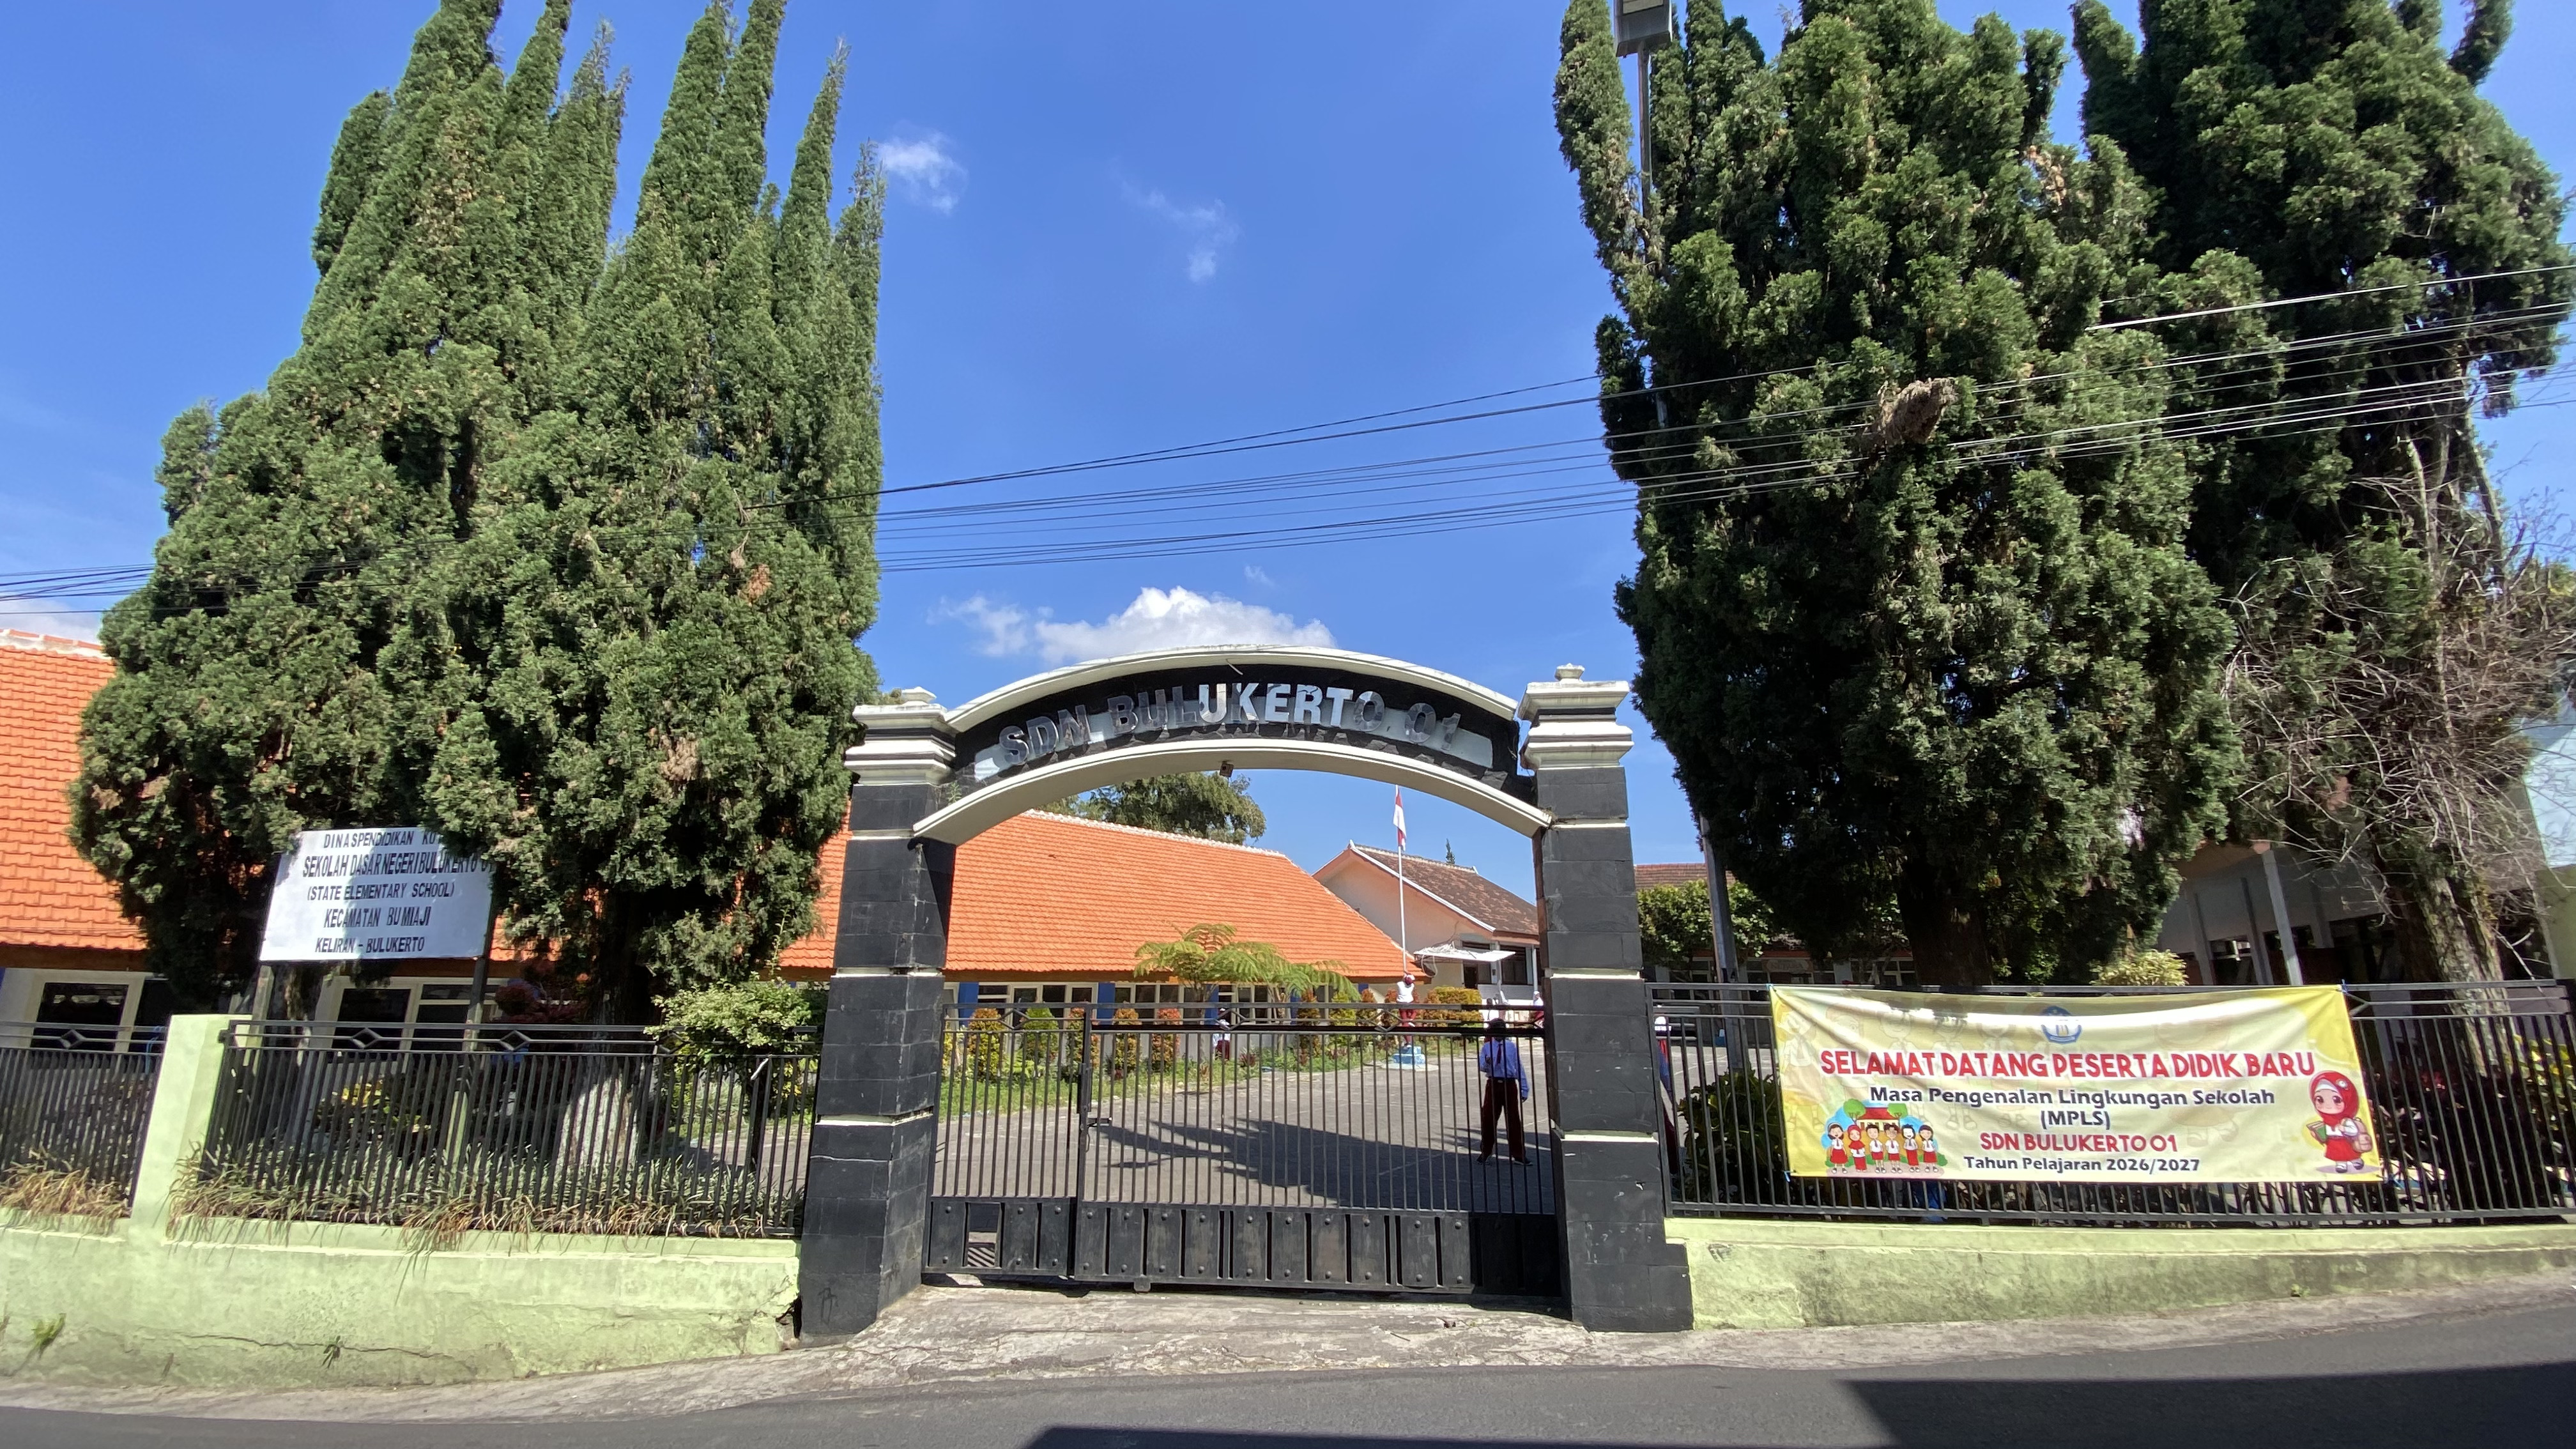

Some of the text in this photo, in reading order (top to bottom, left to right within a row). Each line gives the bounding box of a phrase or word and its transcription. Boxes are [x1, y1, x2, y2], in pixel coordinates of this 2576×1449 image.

[999, 683, 1461, 765] SDN BULUKERTO 01
[357, 831, 413, 847] PENDIDIKAN
[303, 855, 349, 877] SEKOLAH
[350, 854, 380, 876] DASAR
[381, 852, 418, 875] NEGERI
[307, 882, 455, 901] (STATE ELEMENTARY SCHOOL)
[324, 906, 432, 928] KECAMATAN BUMIAJI
[315, 938, 356, 953] KELIRAN
[365, 937, 425, 953] BULUKERTO
[1821, 1050, 2315, 1078] SELAMAT DATANG PESERTA DIDIK BARU
[1870, 1087, 2275, 1109] Masa Pengenalan Lingkungan Sekolah
[2041, 1110, 2111, 1130] (MPLS)
[1981, 1132, 2178, 1152] SDN BULUKERTO 01
[1964, 1156, 2200, 1174] Tahun Pelajaran 2026/2027
